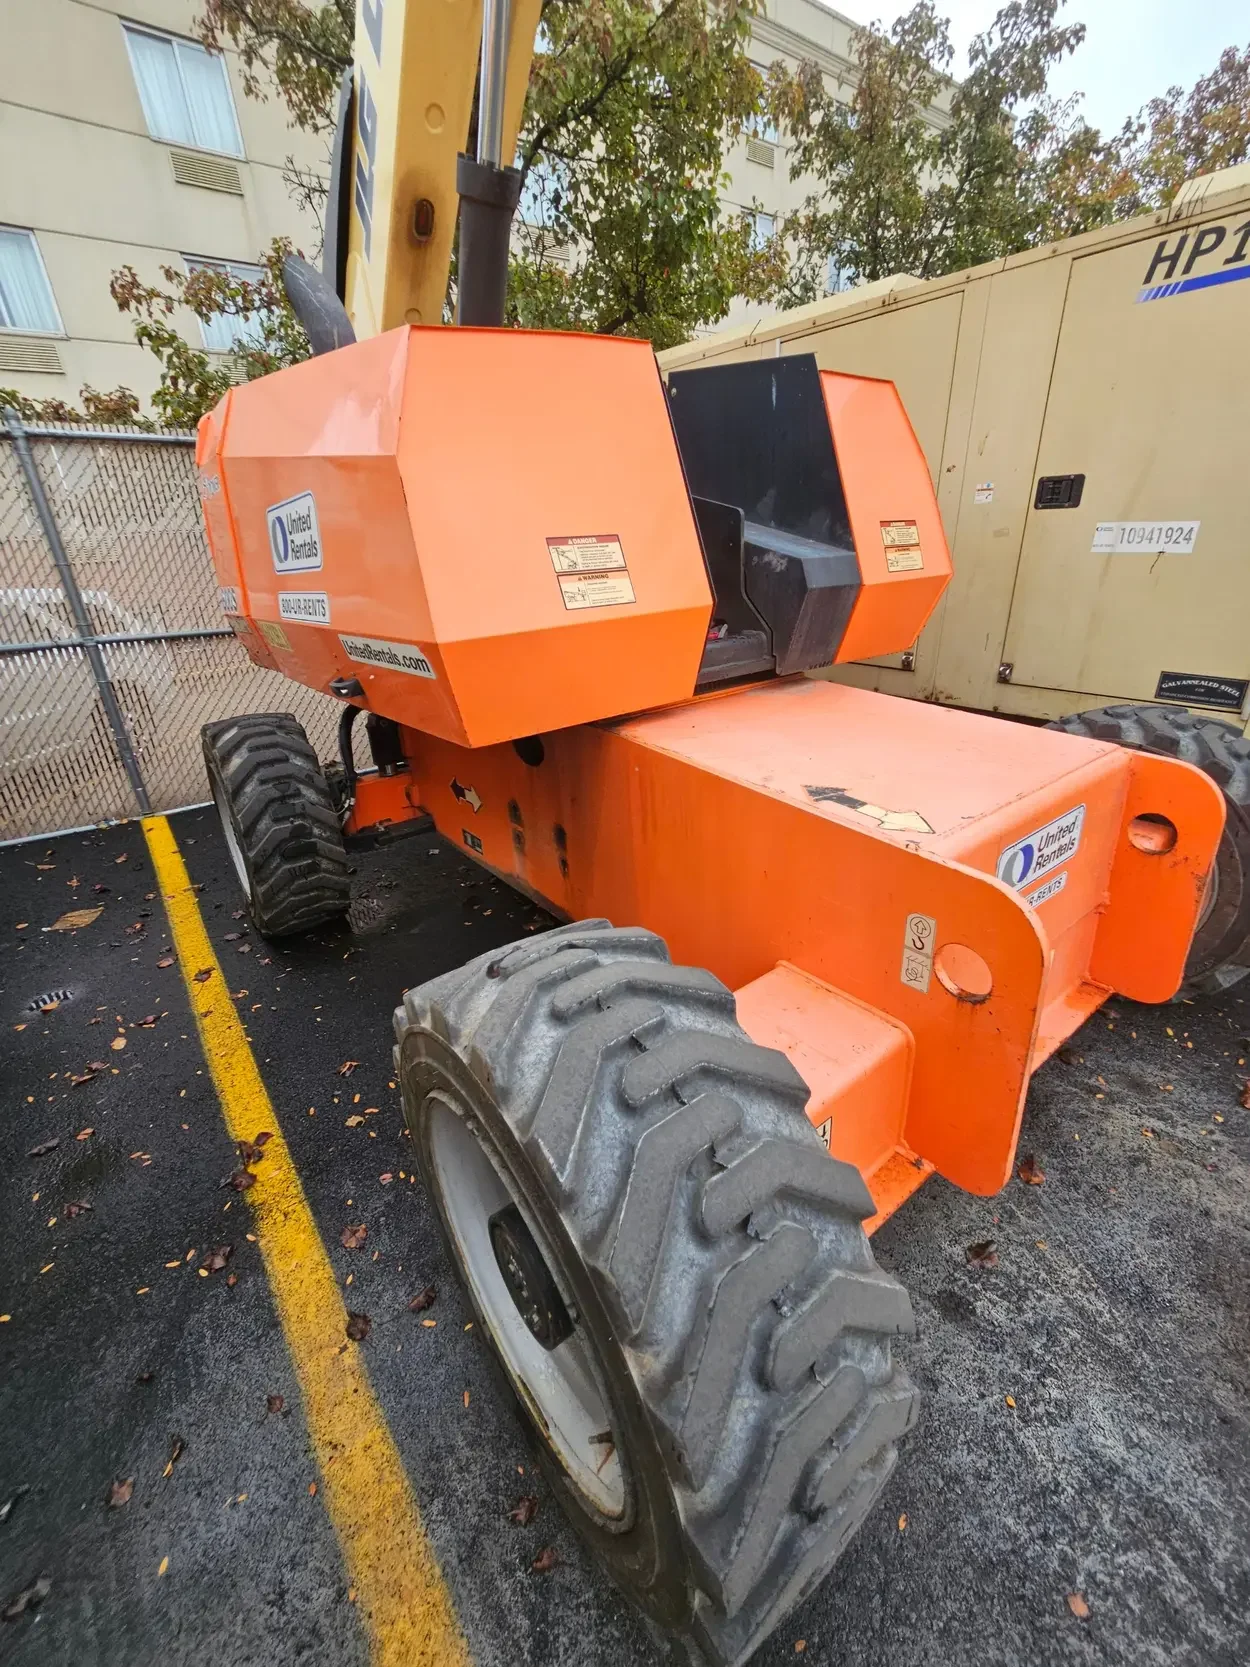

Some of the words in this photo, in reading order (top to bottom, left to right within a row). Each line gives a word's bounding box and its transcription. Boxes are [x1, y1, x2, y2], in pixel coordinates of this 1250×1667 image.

[286, 505, 312, 536] United
[290, 534, 319, 561] Rentals
[572, 537, 598, 545] DANGER
[1119, 526, 1195, 545] 10941924
[582, 573, 609, 581] WARNING
[341, 639, 432, 674] UnitedRentals.com
[1219, 684, 1241, 698] STEEL
[1037, 814, 1078, 853] United
[1033, 835, 1077, 874] Rentals
[1027, 877, 1063, 907] R-RENTS
